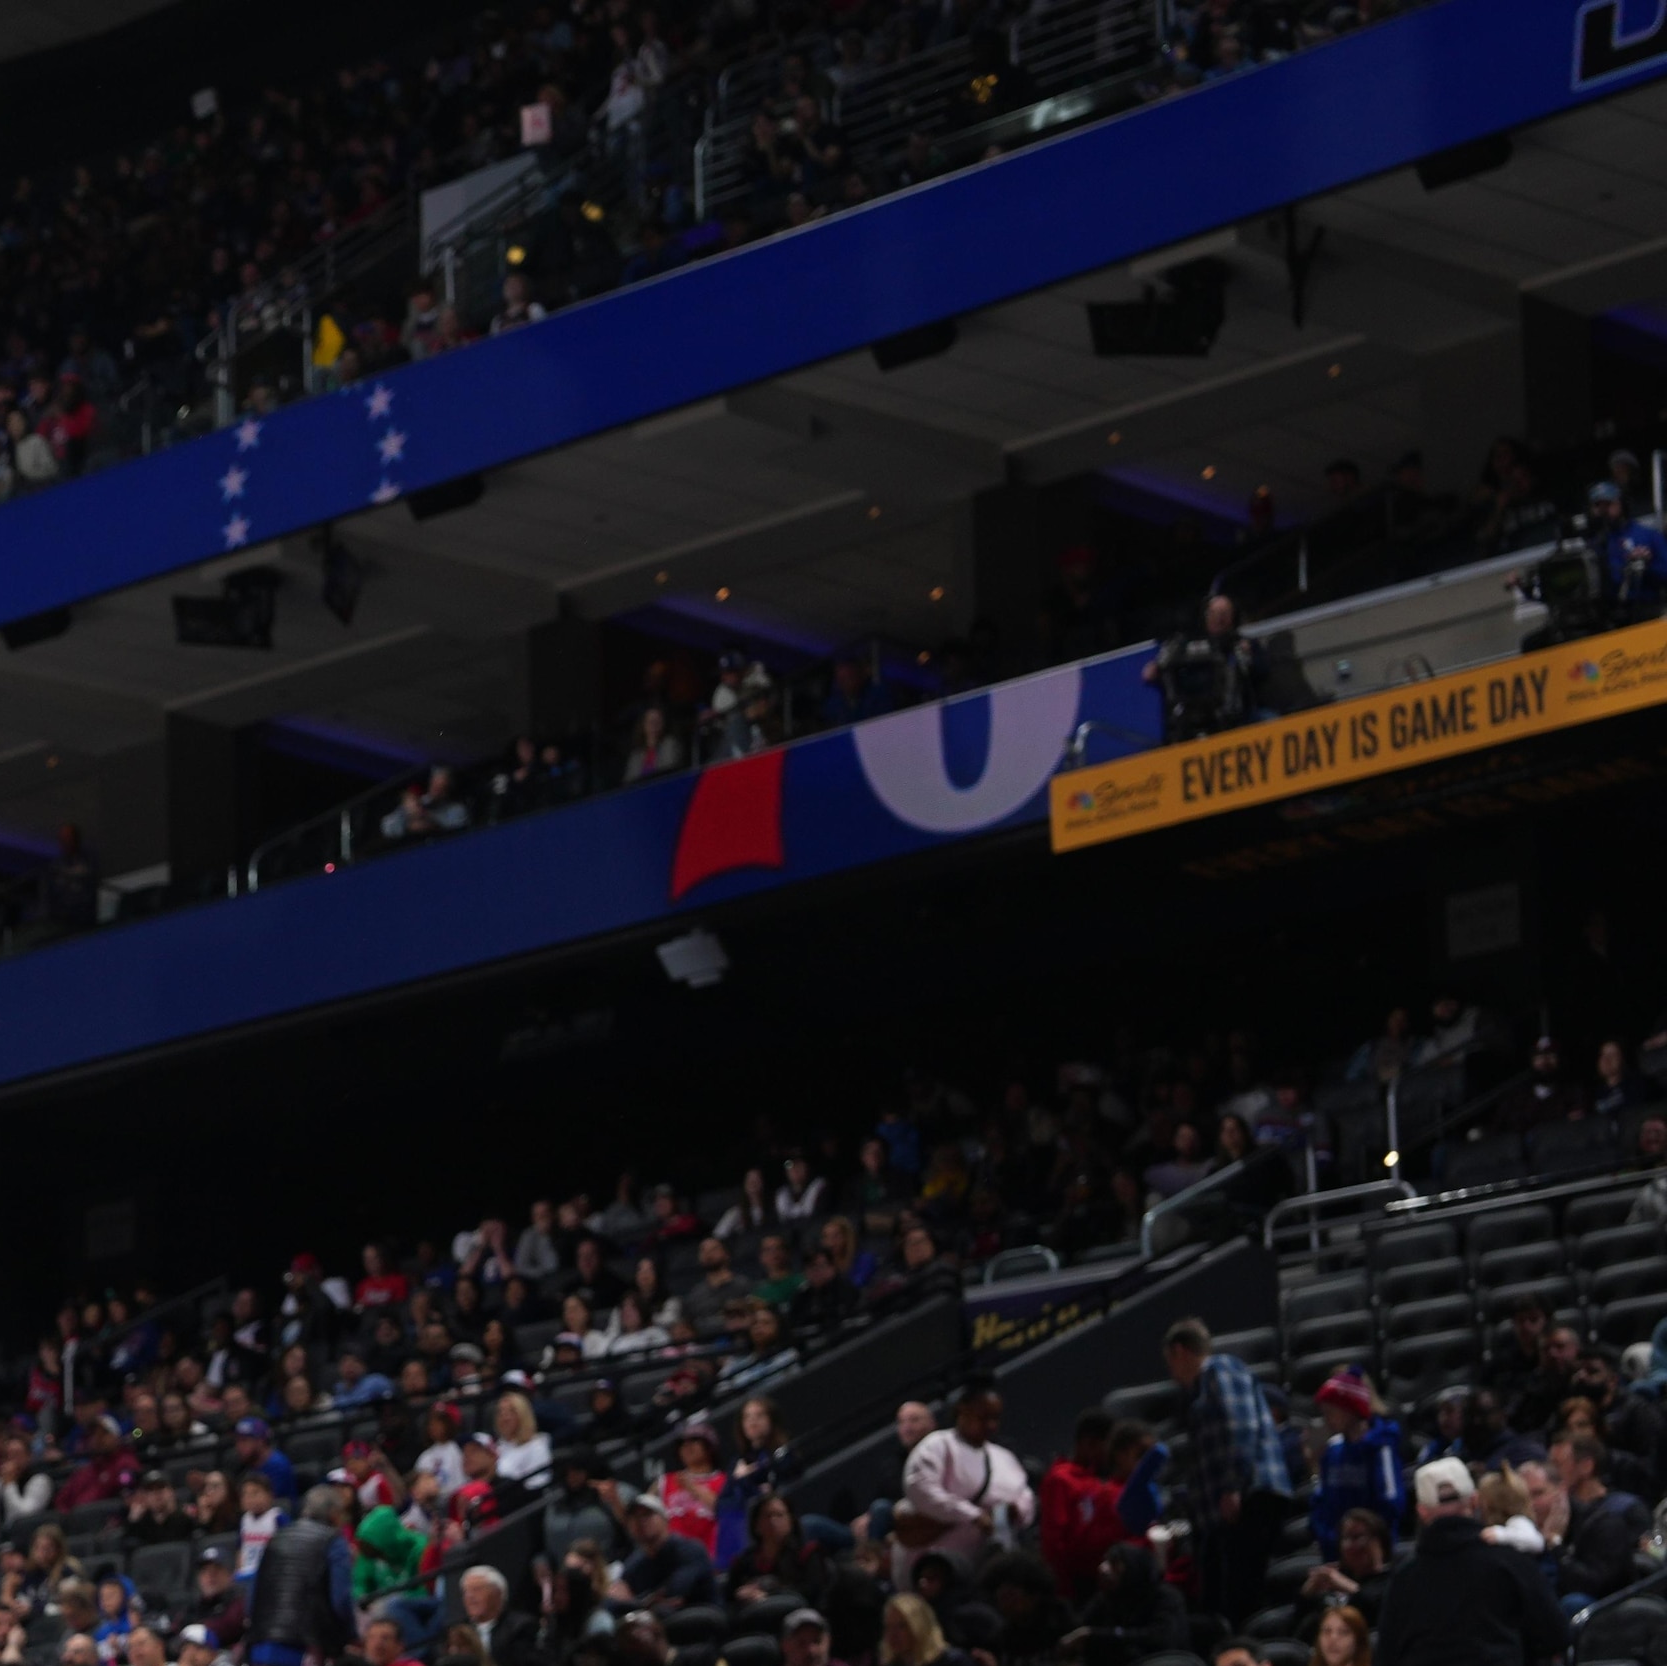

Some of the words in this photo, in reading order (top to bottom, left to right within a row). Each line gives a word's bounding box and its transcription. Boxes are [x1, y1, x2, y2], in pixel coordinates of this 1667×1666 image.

[1180, 734, 1272, 801] EVERY
[1283, 721, 1340, 775] DAY
[1350, 709, 1379, 761] IS
[1390, 687, 1476, 750] GAME
[1488, 667, 1550, 726] DAY
